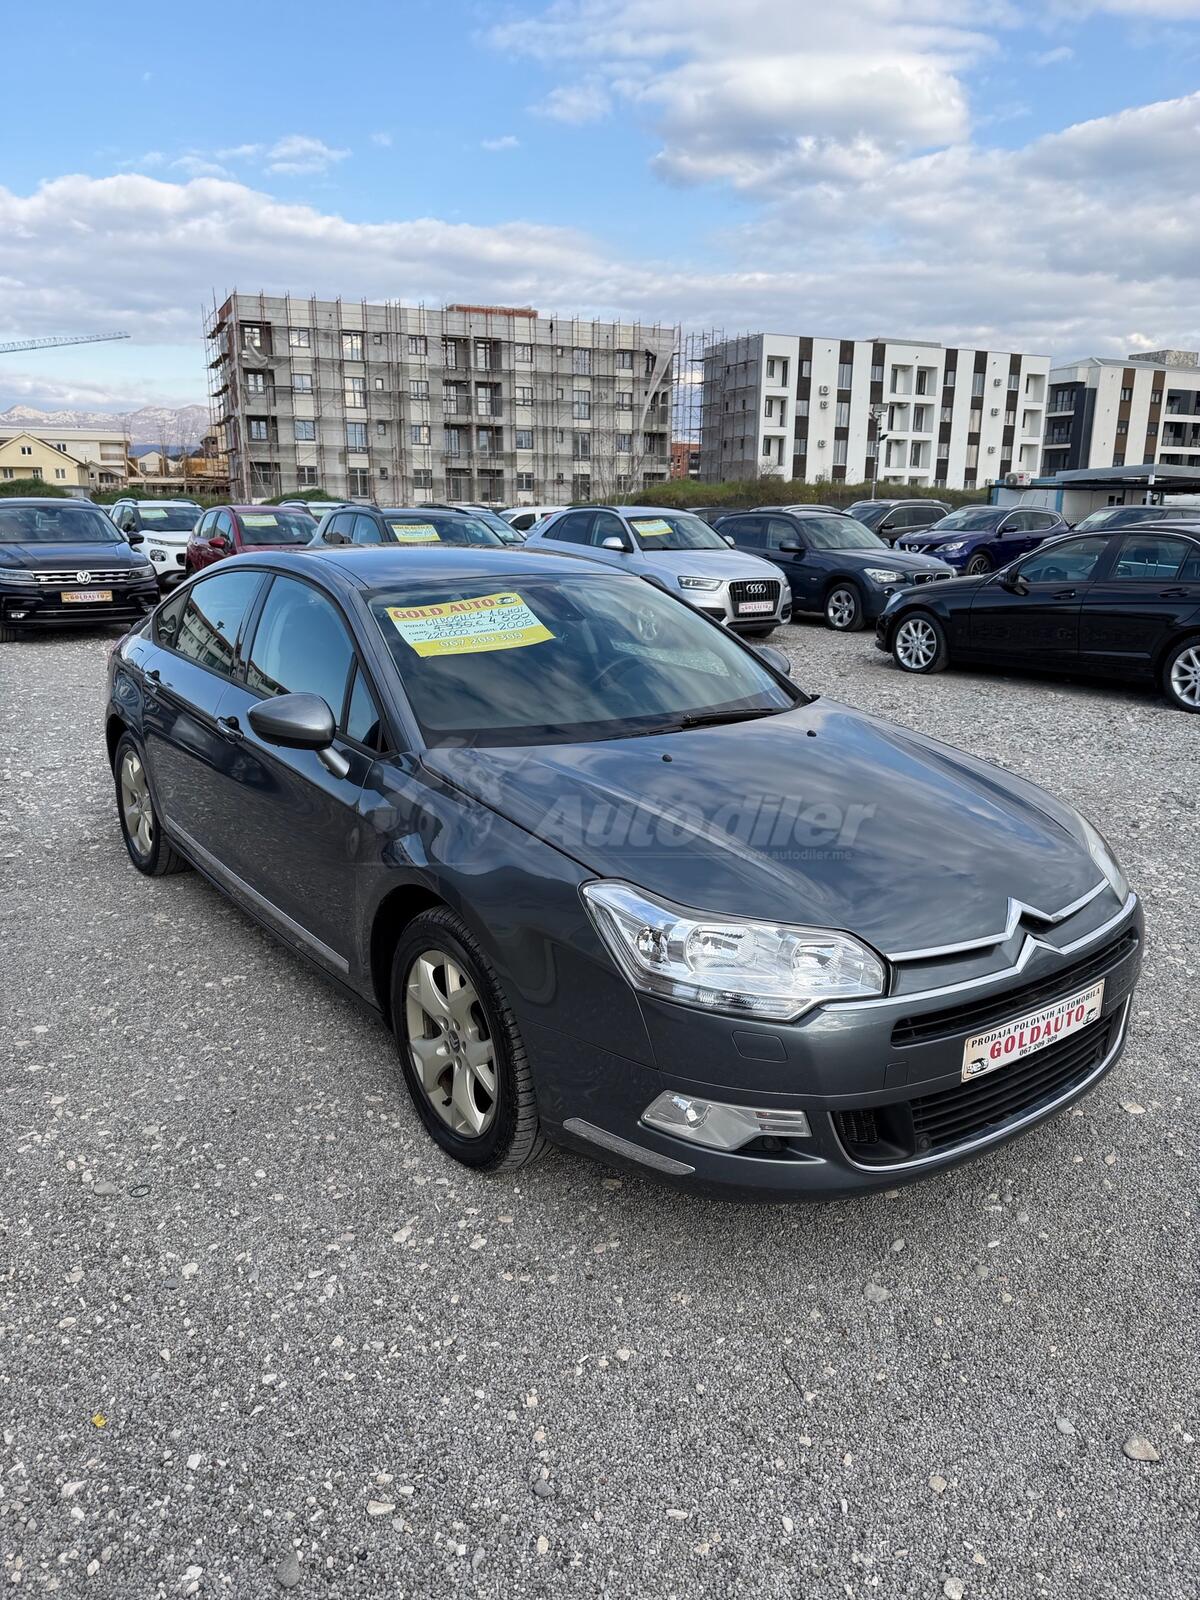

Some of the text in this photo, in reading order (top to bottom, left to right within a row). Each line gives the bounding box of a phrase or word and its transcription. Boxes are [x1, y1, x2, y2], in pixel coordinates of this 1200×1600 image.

[393, 598, 496, 619] GOLD AUTO
[497, 618, 534, 631] 2008
[971, 987, 1100, 1048] PRODAJA POLOVNIH AUTOMOBILA
[990, 1004, 1085, 1060] GOLDAUTO
[1019, 1046, 1032, 1056] 067
[1033, 1040, 1046, 1051] 209
